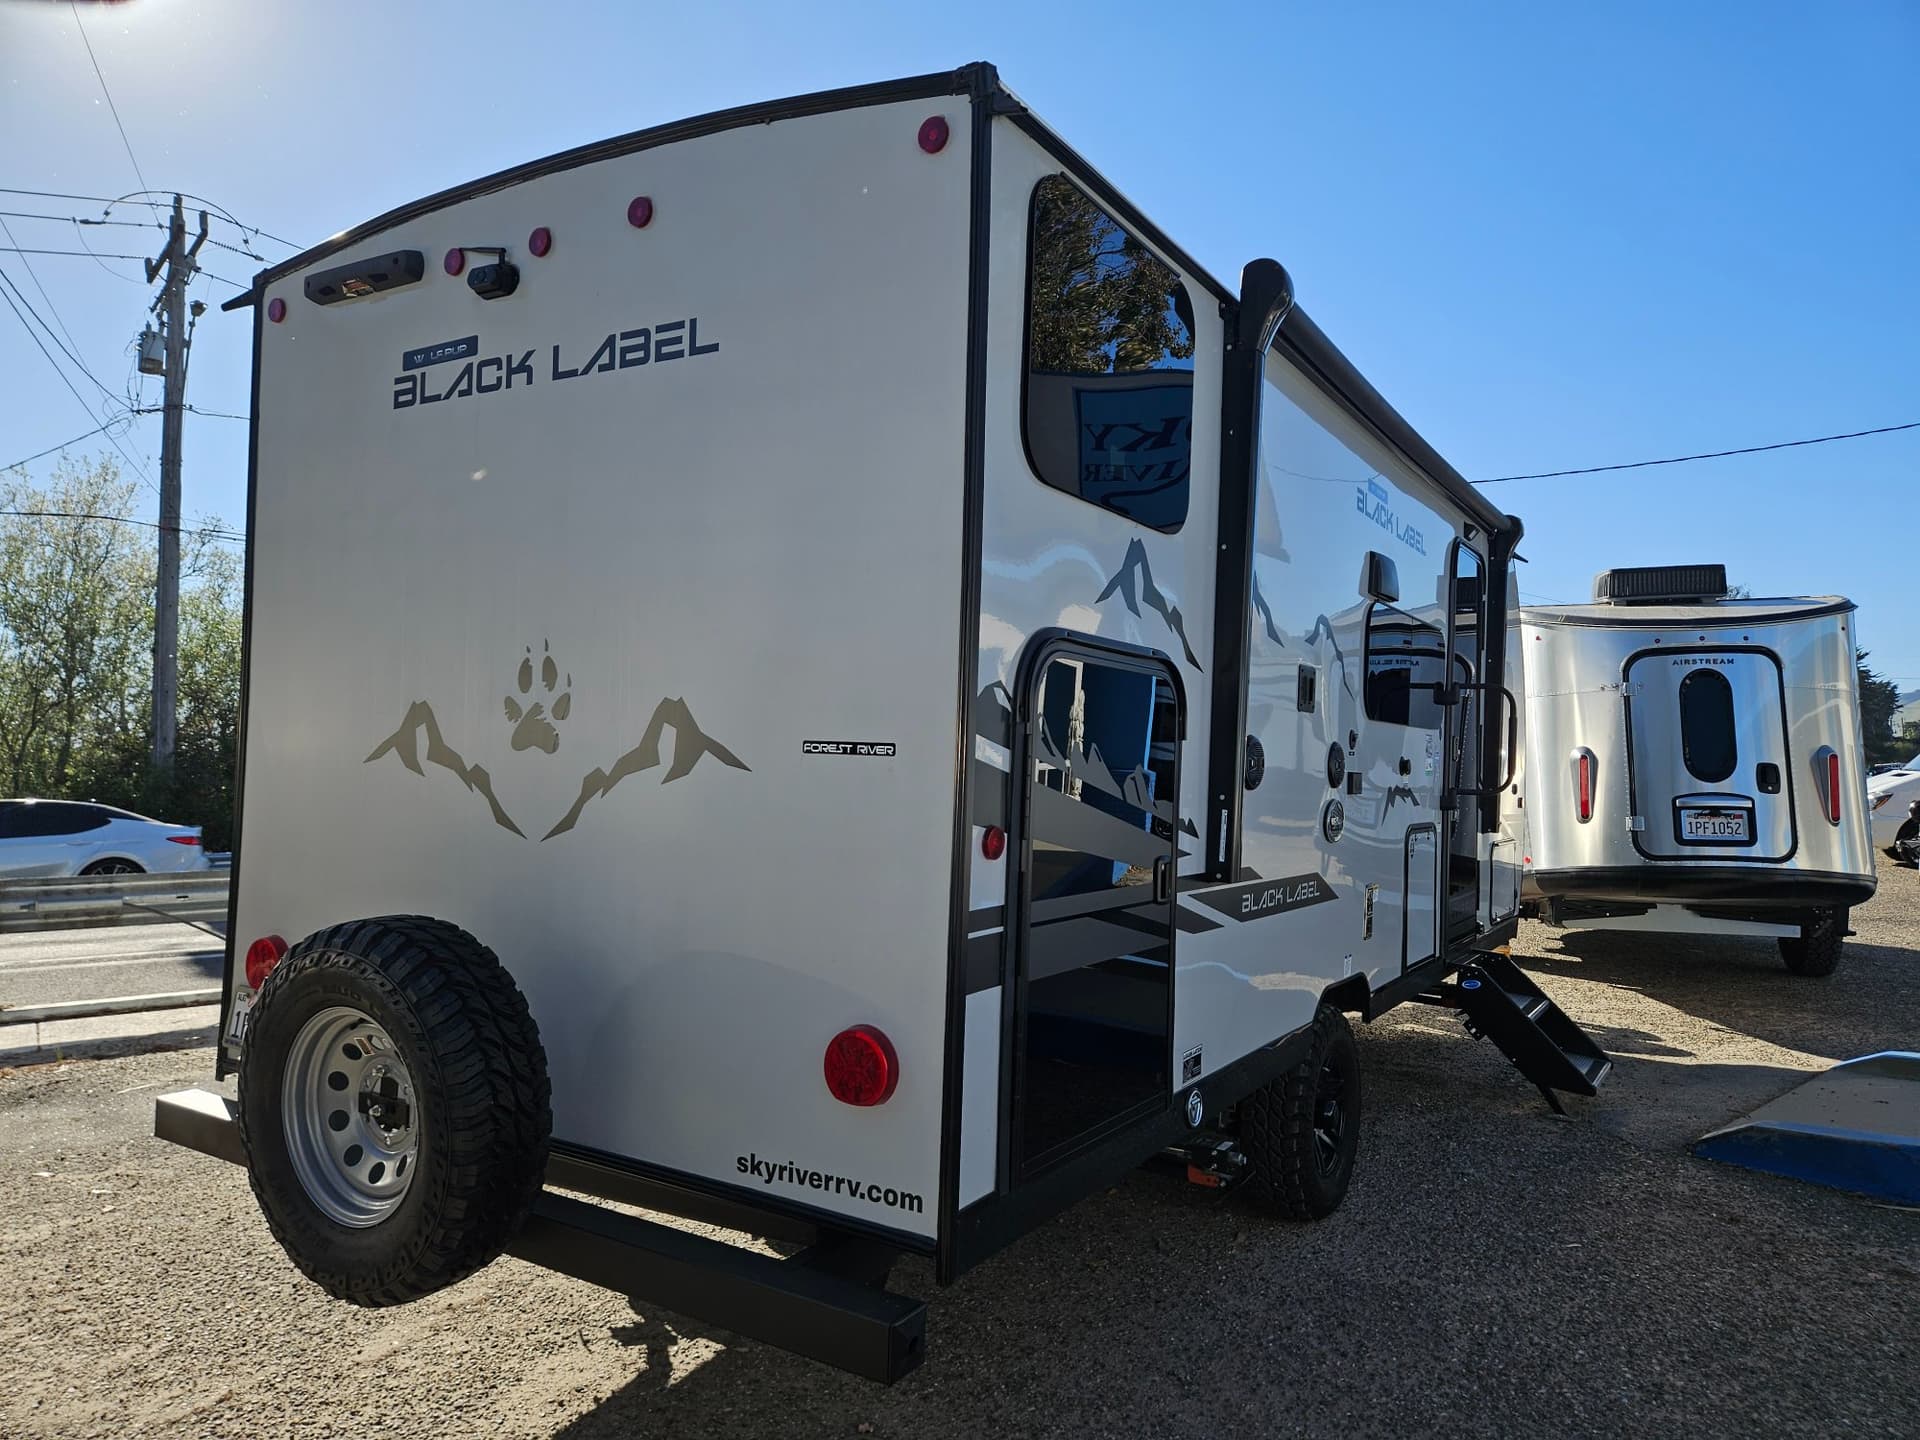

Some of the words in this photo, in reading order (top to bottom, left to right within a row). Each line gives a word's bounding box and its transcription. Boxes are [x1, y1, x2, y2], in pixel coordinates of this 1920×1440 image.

[393, 349, 536, 410] BLACK
[552, 317, 719, 381] LABEL
[1357, 486, 1393, 534] BLACK
[1396, 516, 1426, 556] LABEL
[1672, 658, 1735, 666] AIRSTREAM
[804, 743, 853, 753] FOREST
[857, 745, 894, 755] RIVER
[1687, 821, 1742, 835] 1PF1052
[1242, 890, 1284, 913] BLACK
[1286, 880, 1320, 903] LABEL
[736, 1152, 923, 1213] skyriverrv.com
